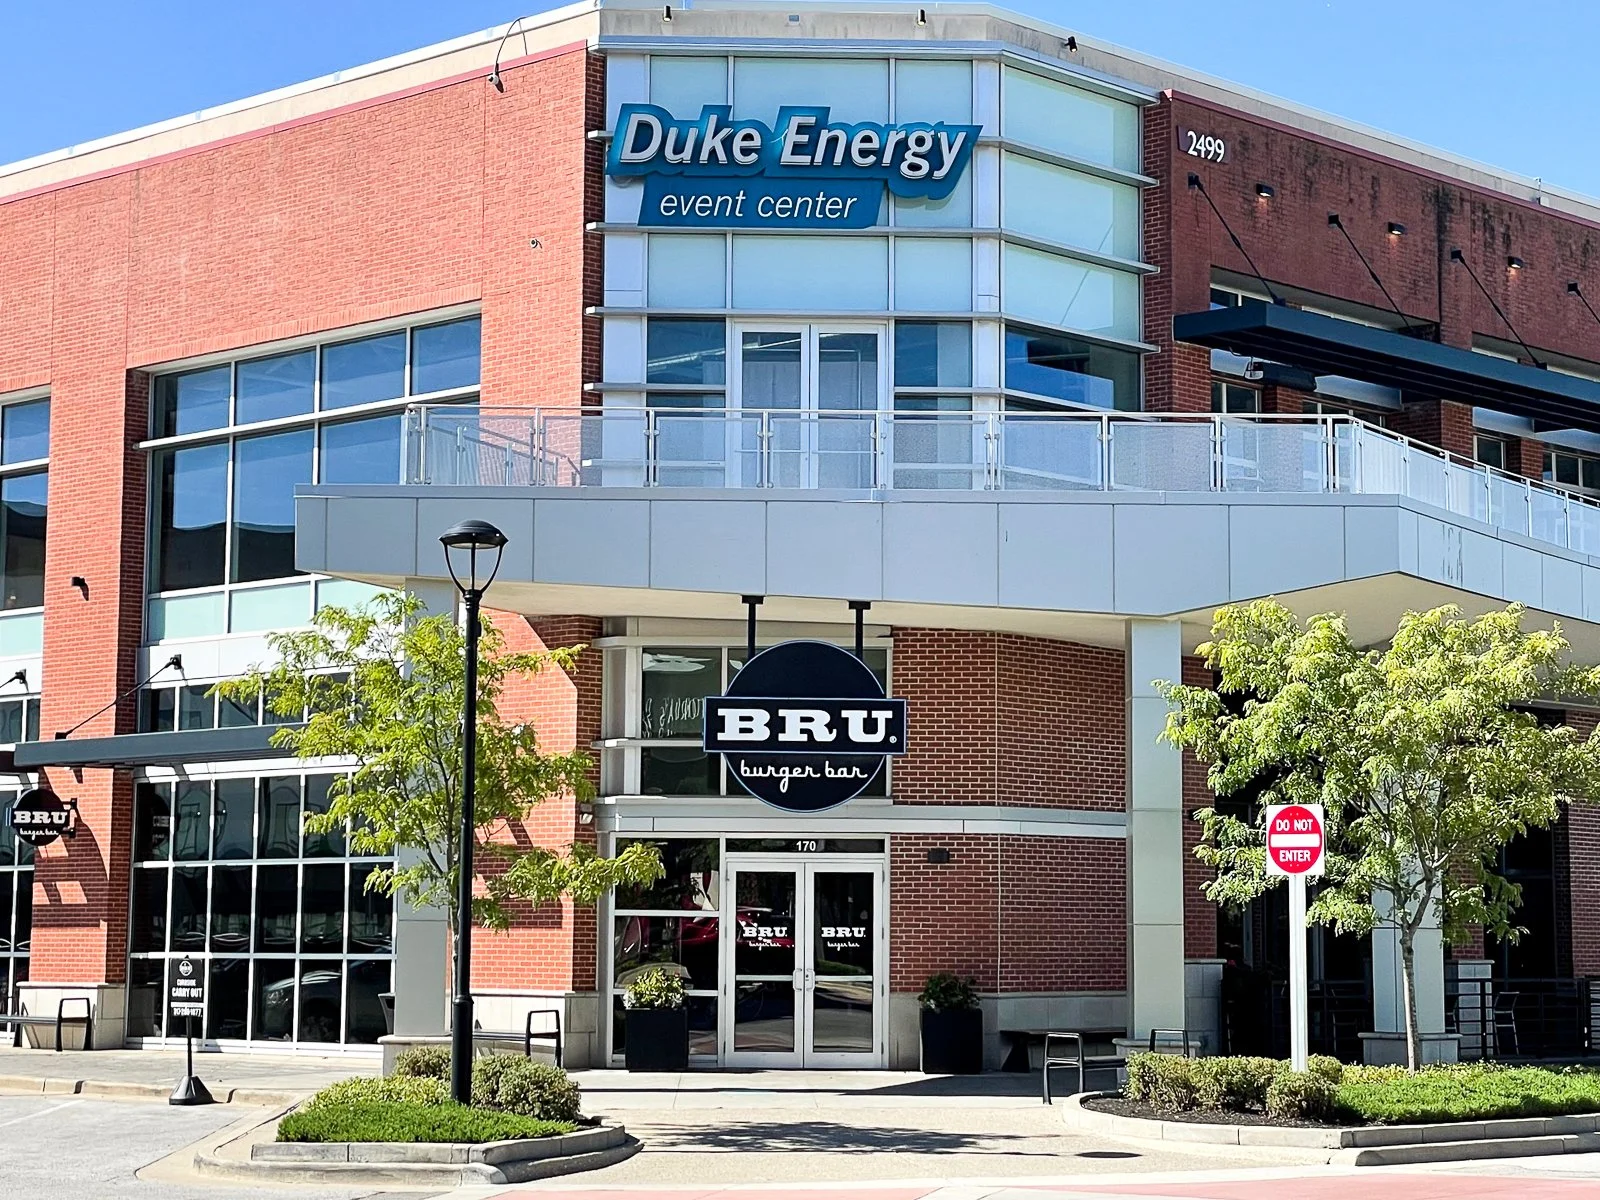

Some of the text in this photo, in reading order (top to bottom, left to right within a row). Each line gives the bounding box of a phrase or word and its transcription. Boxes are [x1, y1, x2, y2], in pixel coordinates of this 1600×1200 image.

[619, 112, 967, 180] Duke Energy
[1187, 130, 1225, 163] 2499
[660, 189, 858, 219] event center
[740, 759, 868, 794] burger bar
[13, 811, 68, 824] BRU
[1276, 819, 1313, 832] DO NOT
[796, 841, 816, 851] 170
[1280, 849, 1311, 862] ENTER
[172, 987, 203, 998] CARRY OUT
